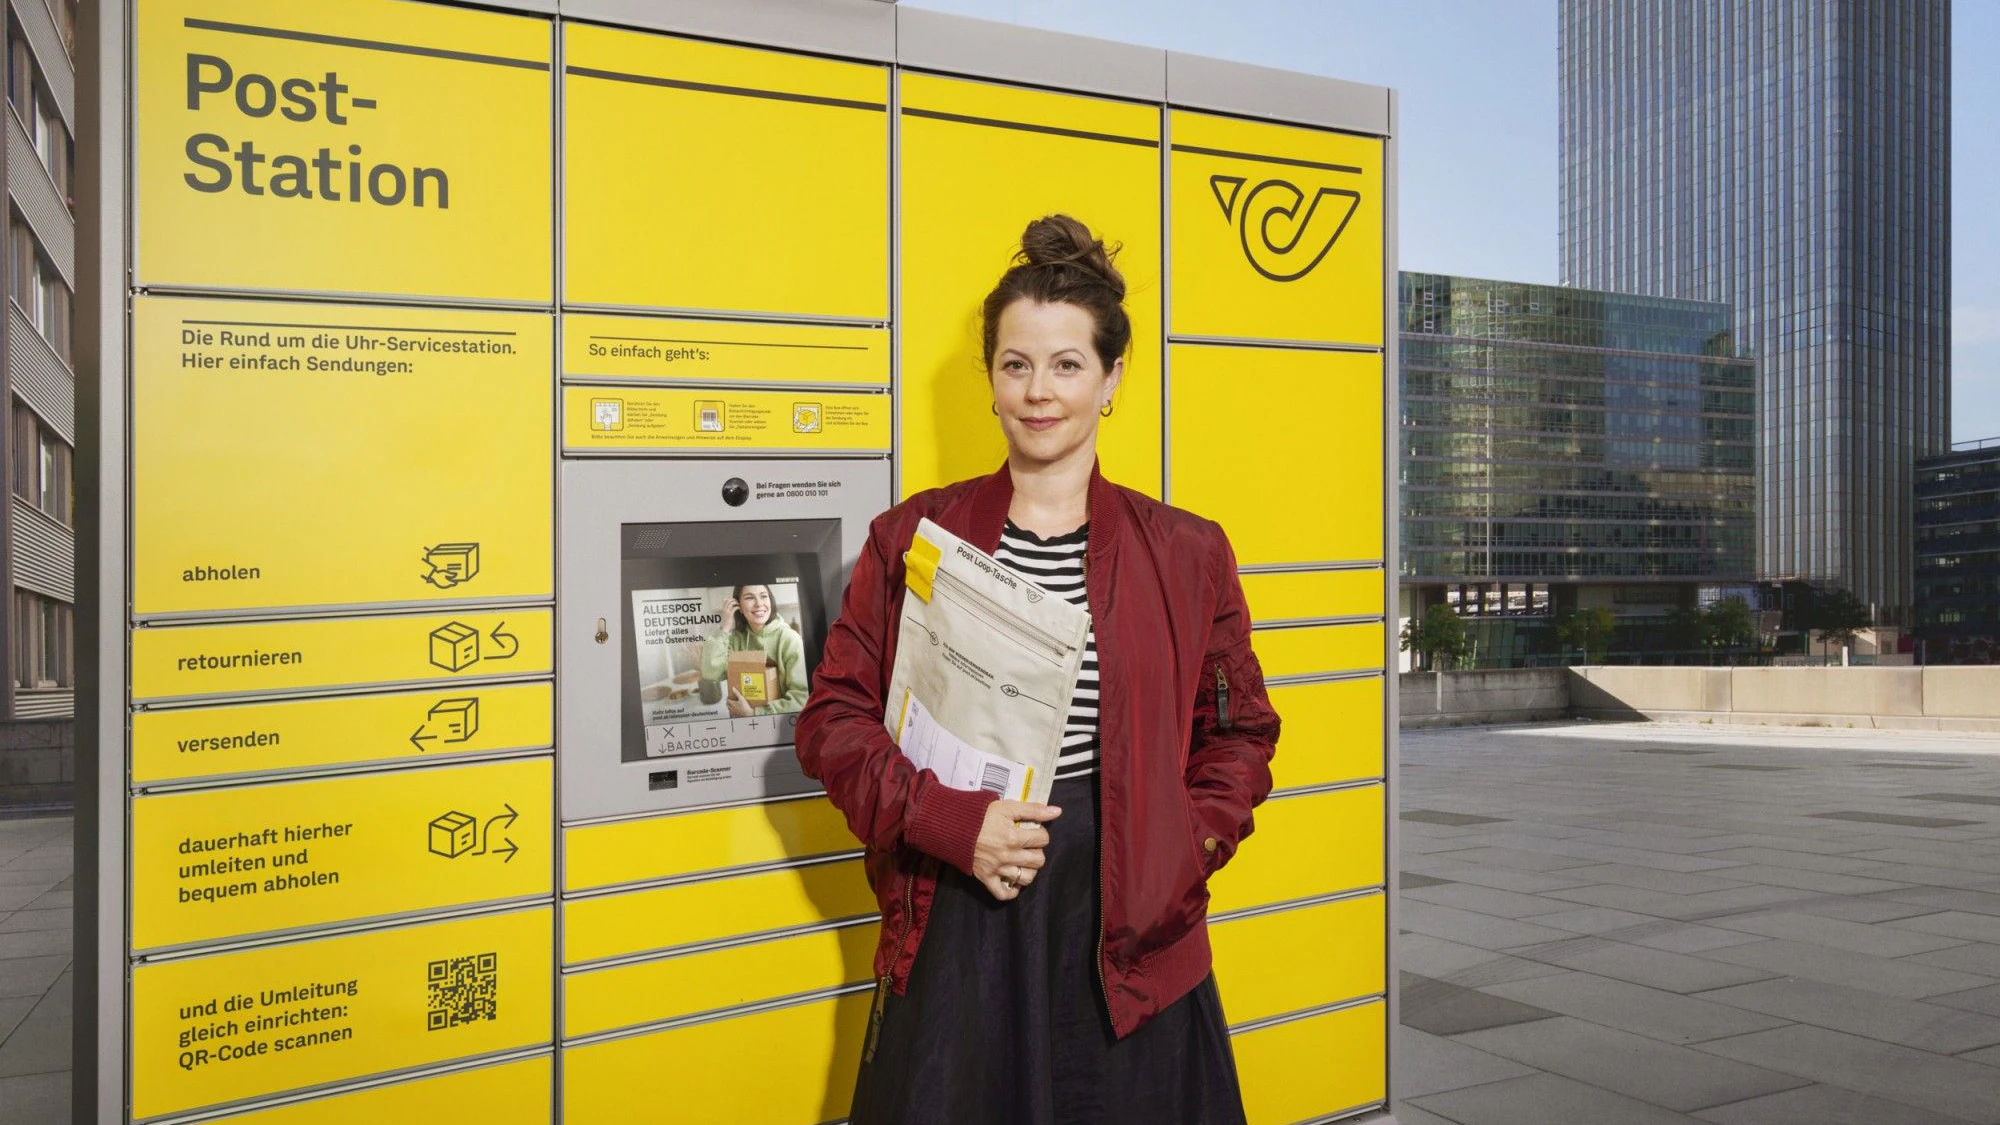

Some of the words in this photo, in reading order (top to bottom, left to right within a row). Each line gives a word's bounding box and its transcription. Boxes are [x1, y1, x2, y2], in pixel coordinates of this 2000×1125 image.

[187, 53, 376, 125] Post-
[184, 133, 448, 209] Station
[183, 330, 213, 345] Die
[221, 331, 270, 347] Rund
[277, 337, 304, 348] um
[312, 334, 339, 349] die
[346, 336, 516, 354] Uhr-Servicestation.
[589, 344, 606, 356] So
[611, 344, 661, 358] einfach
[183, 353, 223, 368] Hier
[230, 354, 299, 370] einfach
[307, 356, 412, 376] Sendungen:
[183, 565, 260, 581] abholen
[957, 546, 973, 561] Post
[975, 557, 1017, 589] Loop-Tasche
[644, 603, 702, 613] ALLESPOST
[644, 615, 721, 627] DEUTSCHLAND
[645, 628, 669, 636] Liefert
[666, 635, 706, 643] Österreich.
[178, 650, 301, 670] retournieren
[178, 731, 279, 752] versenden
[668, 737, 726, 751] BARCODE
[179, 829, 278, 854] dauerhaft
[285, 823, 352, 842] hierher
[179, 857, 265, 878] umleiten
[273, 849, 308, 867] und
[179, 880, 256, 903] bequem
[264, 871, 338, 892] abholen
[180, 999, 217, 1019] und
[224, 995, 253, 1012] die
[261, 979, 358, 1007] Umleitung
[179, 1020, 238, 1048] gleich
[245, 1005, 348, 1033] einrichten:
[179, 1040, 268, 1070] QR-Code
[275, 1028, 352, 1051] scannen
